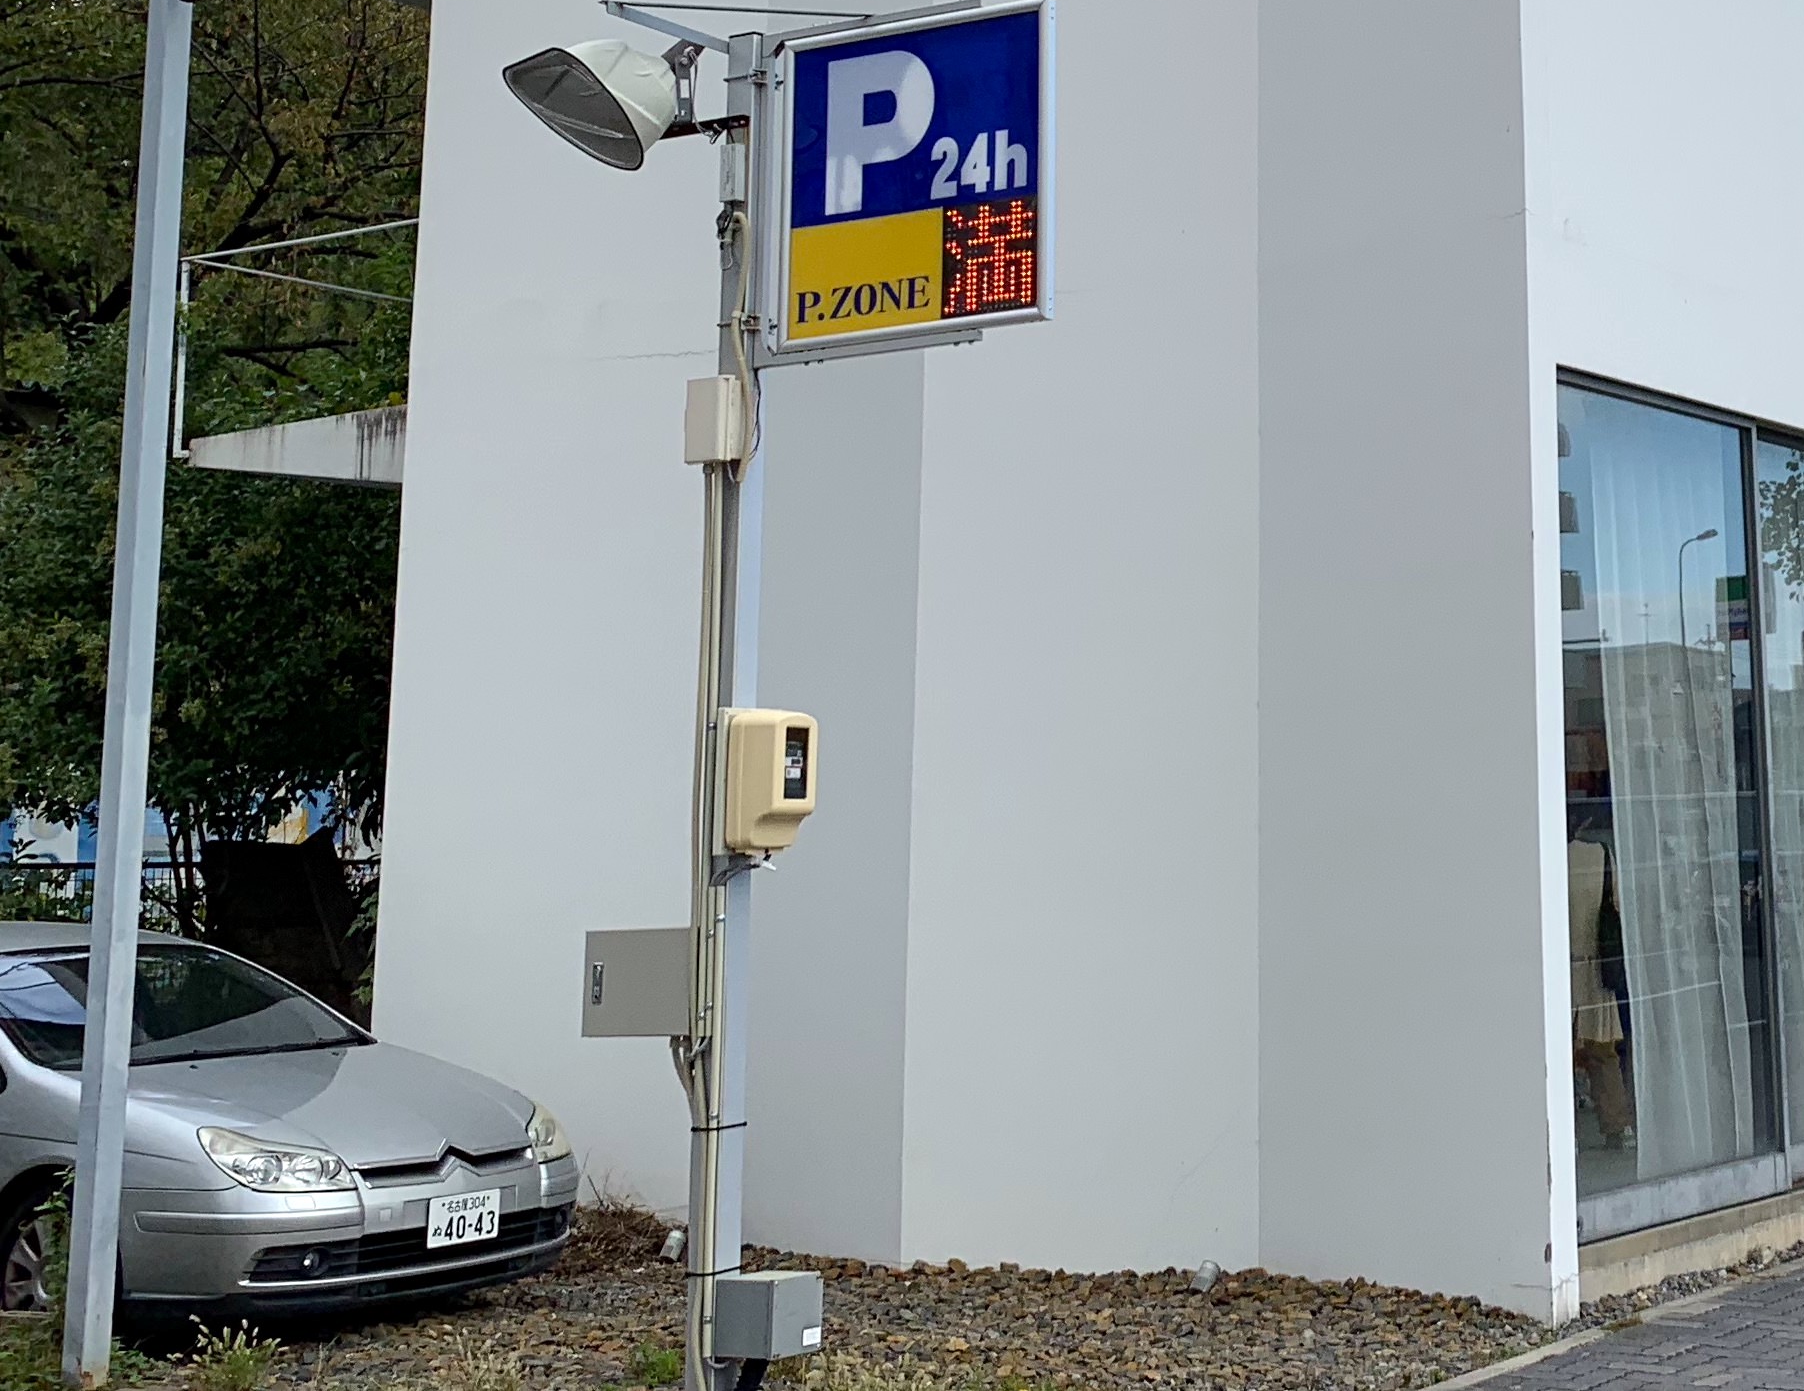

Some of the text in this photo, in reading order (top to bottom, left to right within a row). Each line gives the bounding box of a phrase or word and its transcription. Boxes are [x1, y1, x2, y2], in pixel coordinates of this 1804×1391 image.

[825, 50, 935, 216] P
[930, 129, 1028, 200] 24h
[944, 200, 1033, 314] 満
[796, 275, 930, 325] P.ZONE
[444, 1210, 496, 1241] 40-43
